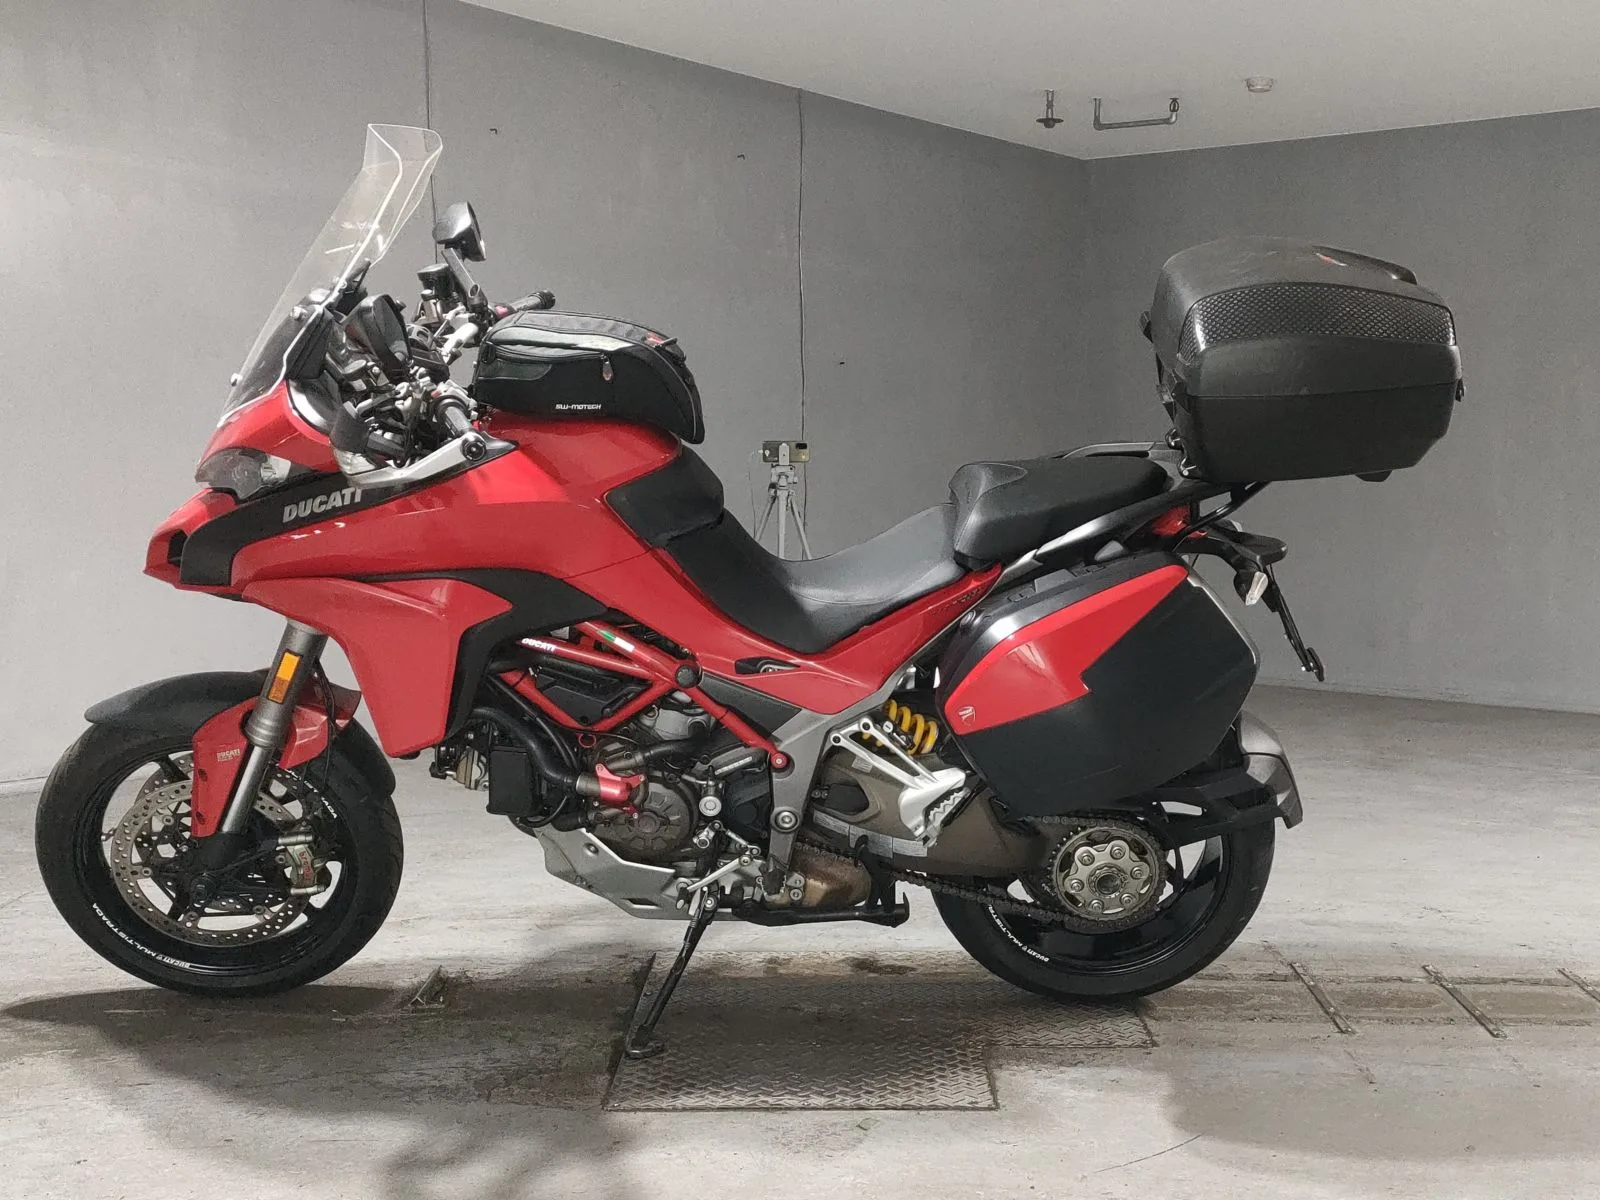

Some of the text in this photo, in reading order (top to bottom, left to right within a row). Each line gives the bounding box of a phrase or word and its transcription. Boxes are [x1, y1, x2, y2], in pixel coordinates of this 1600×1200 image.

[282, 486, 363, 523] DUCATI
[521, 637, 556, 652] DUCATI
[92, 903, 157, 957] MULTISTRADA
[988, 904, 1050, 962] DUCATI MULTISTR
